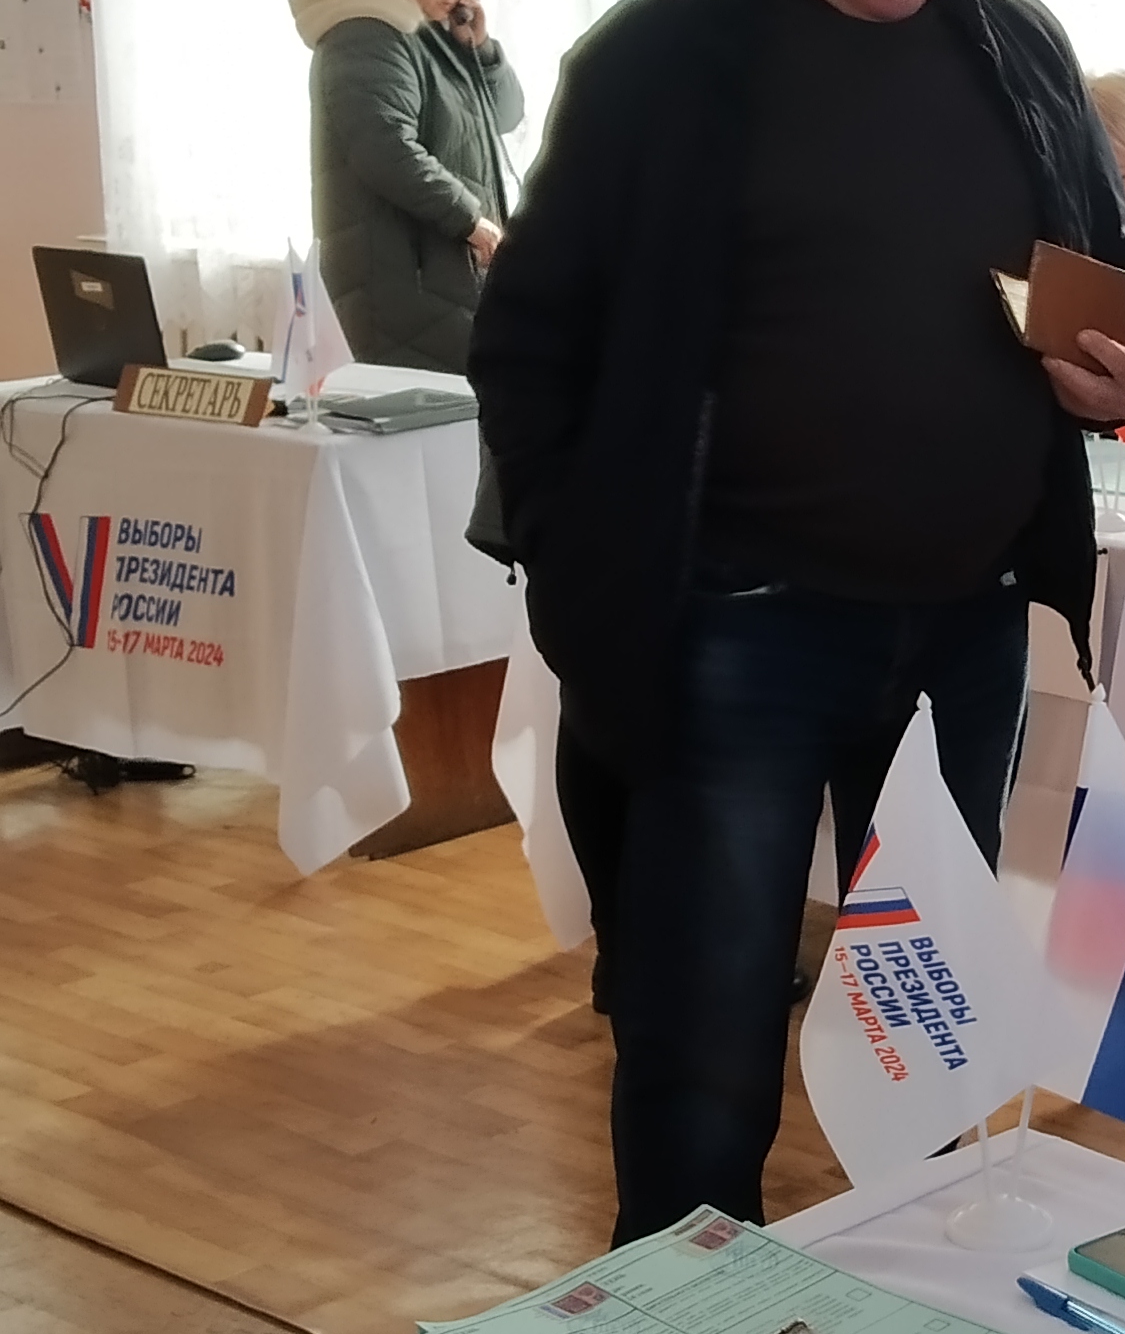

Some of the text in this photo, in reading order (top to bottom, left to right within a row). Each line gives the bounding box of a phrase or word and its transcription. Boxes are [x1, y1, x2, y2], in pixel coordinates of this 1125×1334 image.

[137, 372, 242, 418] СЕКРЕТАРЬ
[117, 518, 202, 553] ВЫБОРЫ
[143, 633, 184, 660] МАРТА
[187, 640, 224, 666] 2024
[850, 944, 912, 1028] РОССИИ
[878, 941, 968, 1071] ПРЕЗИДЕНТА
[909, 936, 978, 1027] ВЫБОРЫ
[847, 992, 888, 1044] МАРТА
[874, 1046, 909, 1082] 2024
